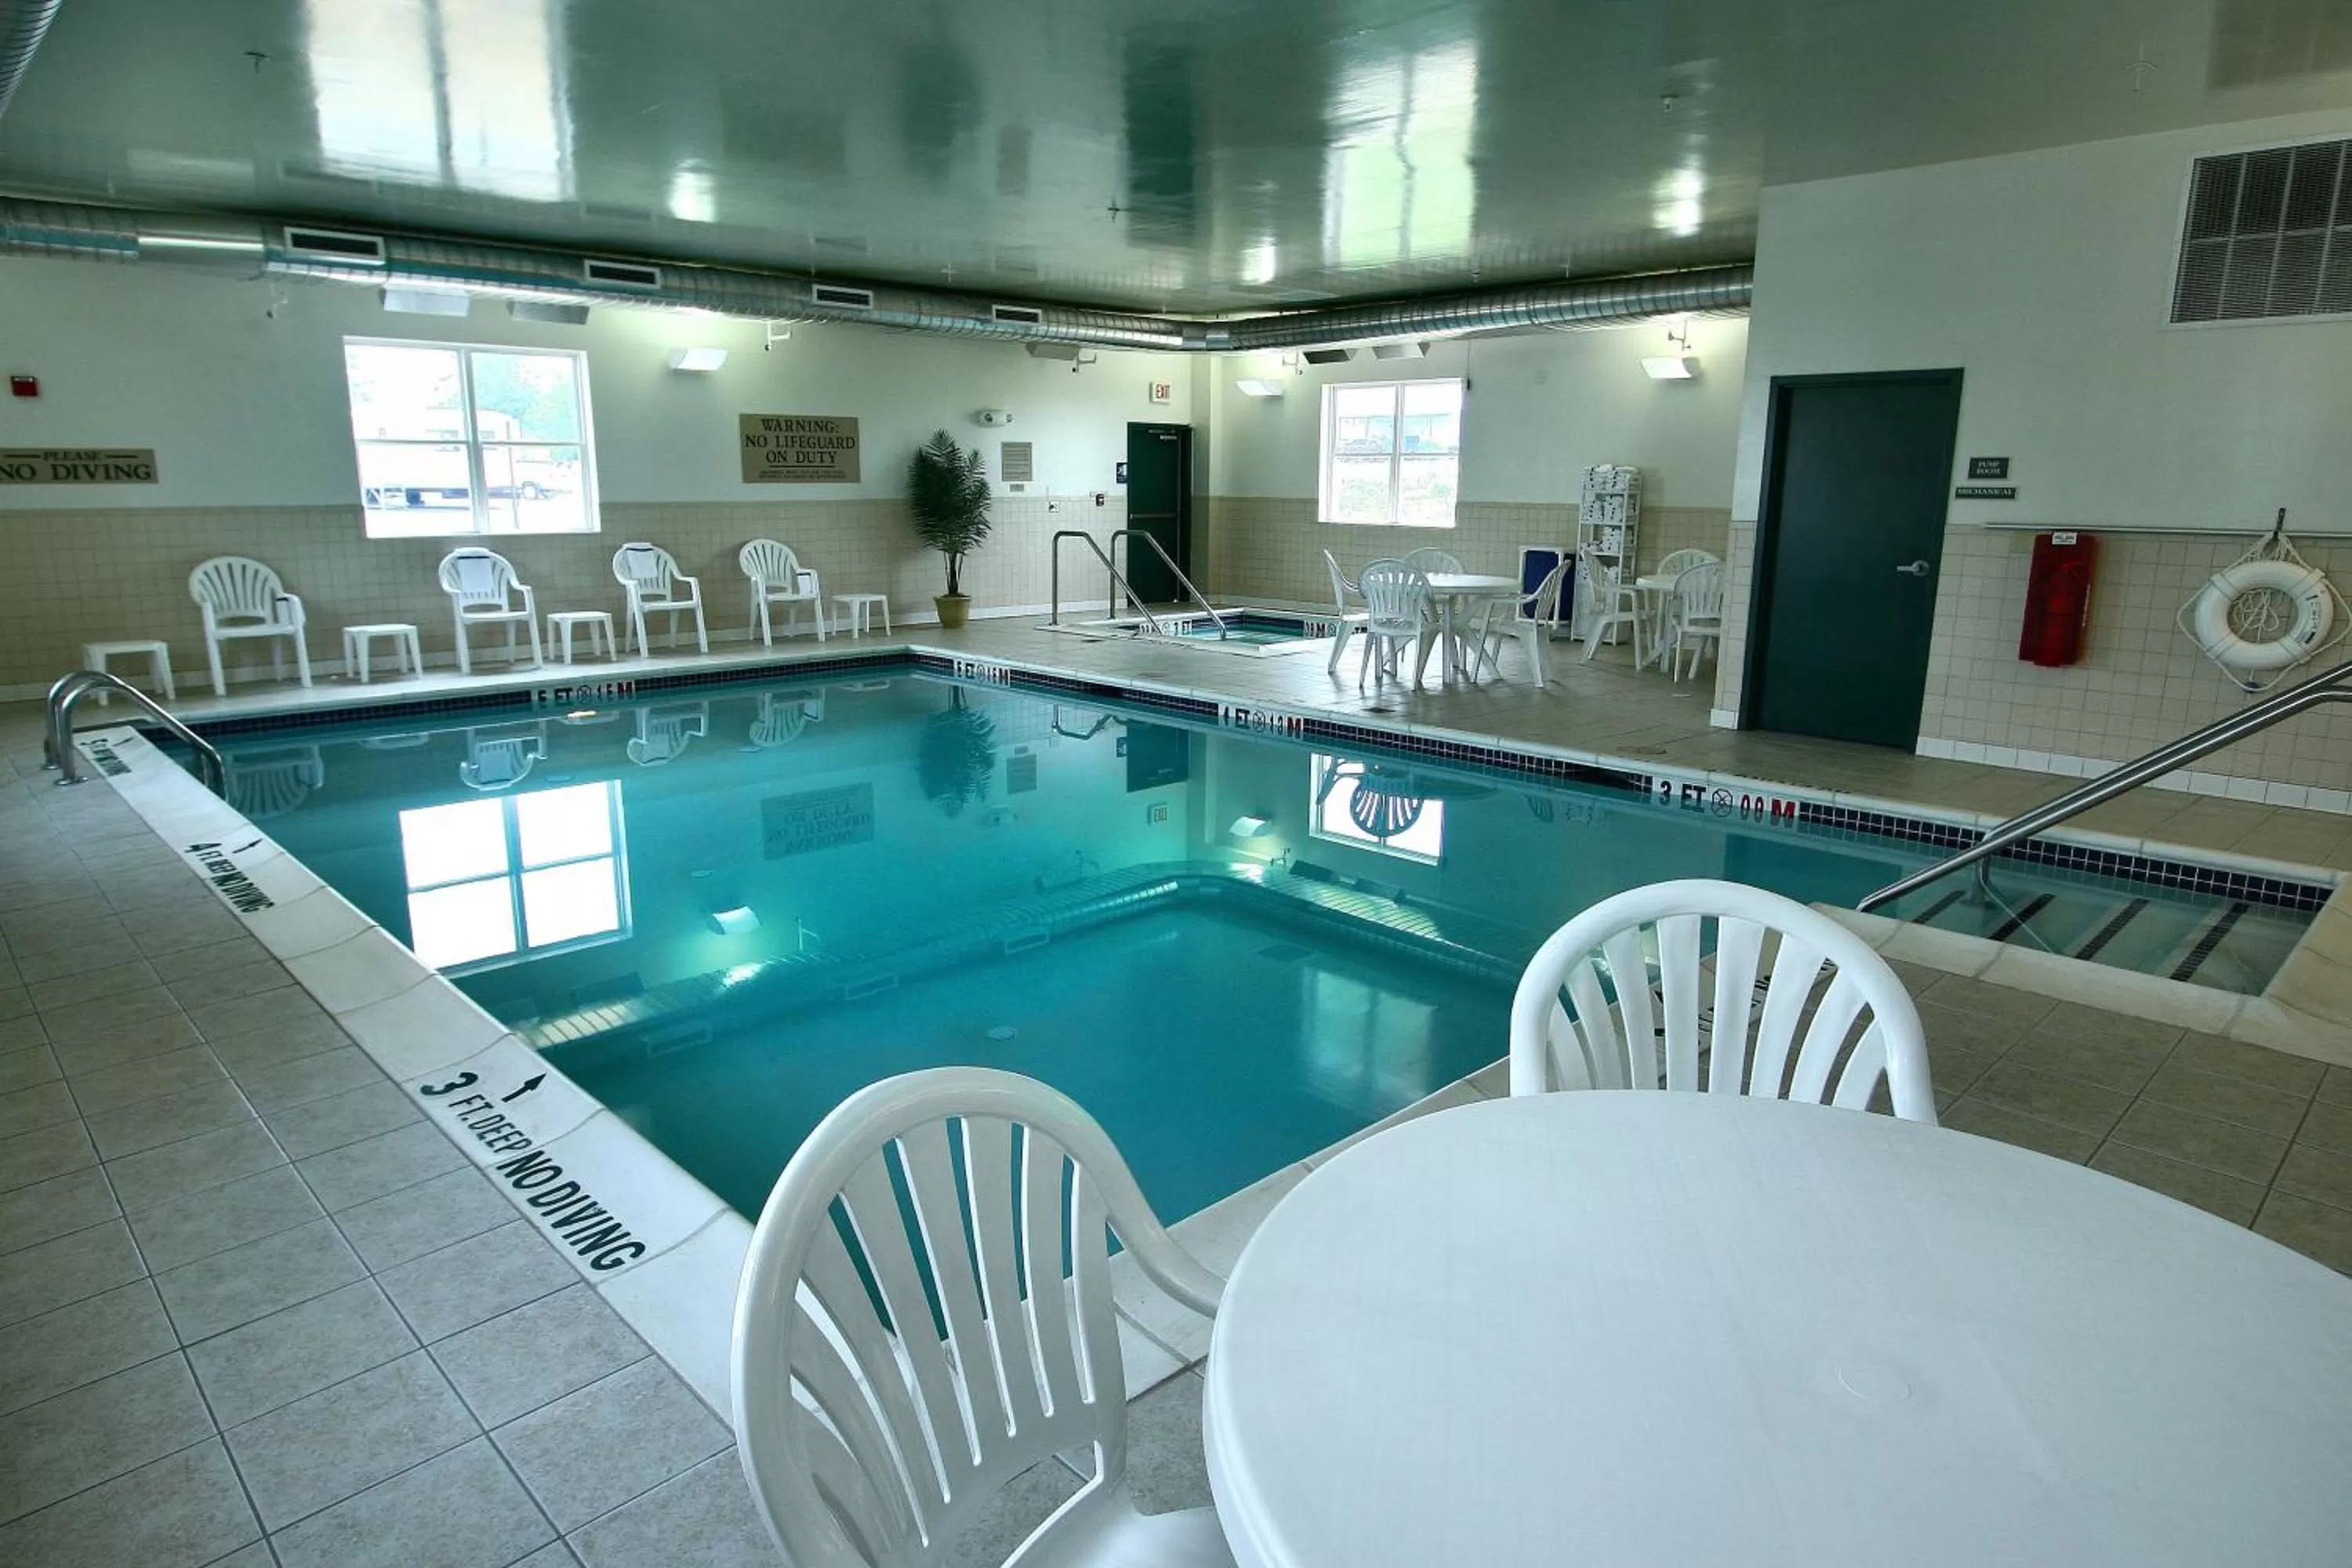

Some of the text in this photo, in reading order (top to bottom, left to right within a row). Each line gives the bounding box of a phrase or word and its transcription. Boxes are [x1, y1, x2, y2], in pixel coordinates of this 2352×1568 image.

[761, 418, 840, 434] WARNING:
[745, 435, 856, 449] NO LIFEGUARD
[43, 451, 100, 462] PLEASE
[765, 450, 837, 464] ON DUTY
[0, 463, 151, 481] NO DIVING
[1681, 783, 1707, 802] FT
[420, 1072, 478, 1095] 3
[496, 1150, 564, 1189] NO
[526, 1180, 646, 1271] DIVING
